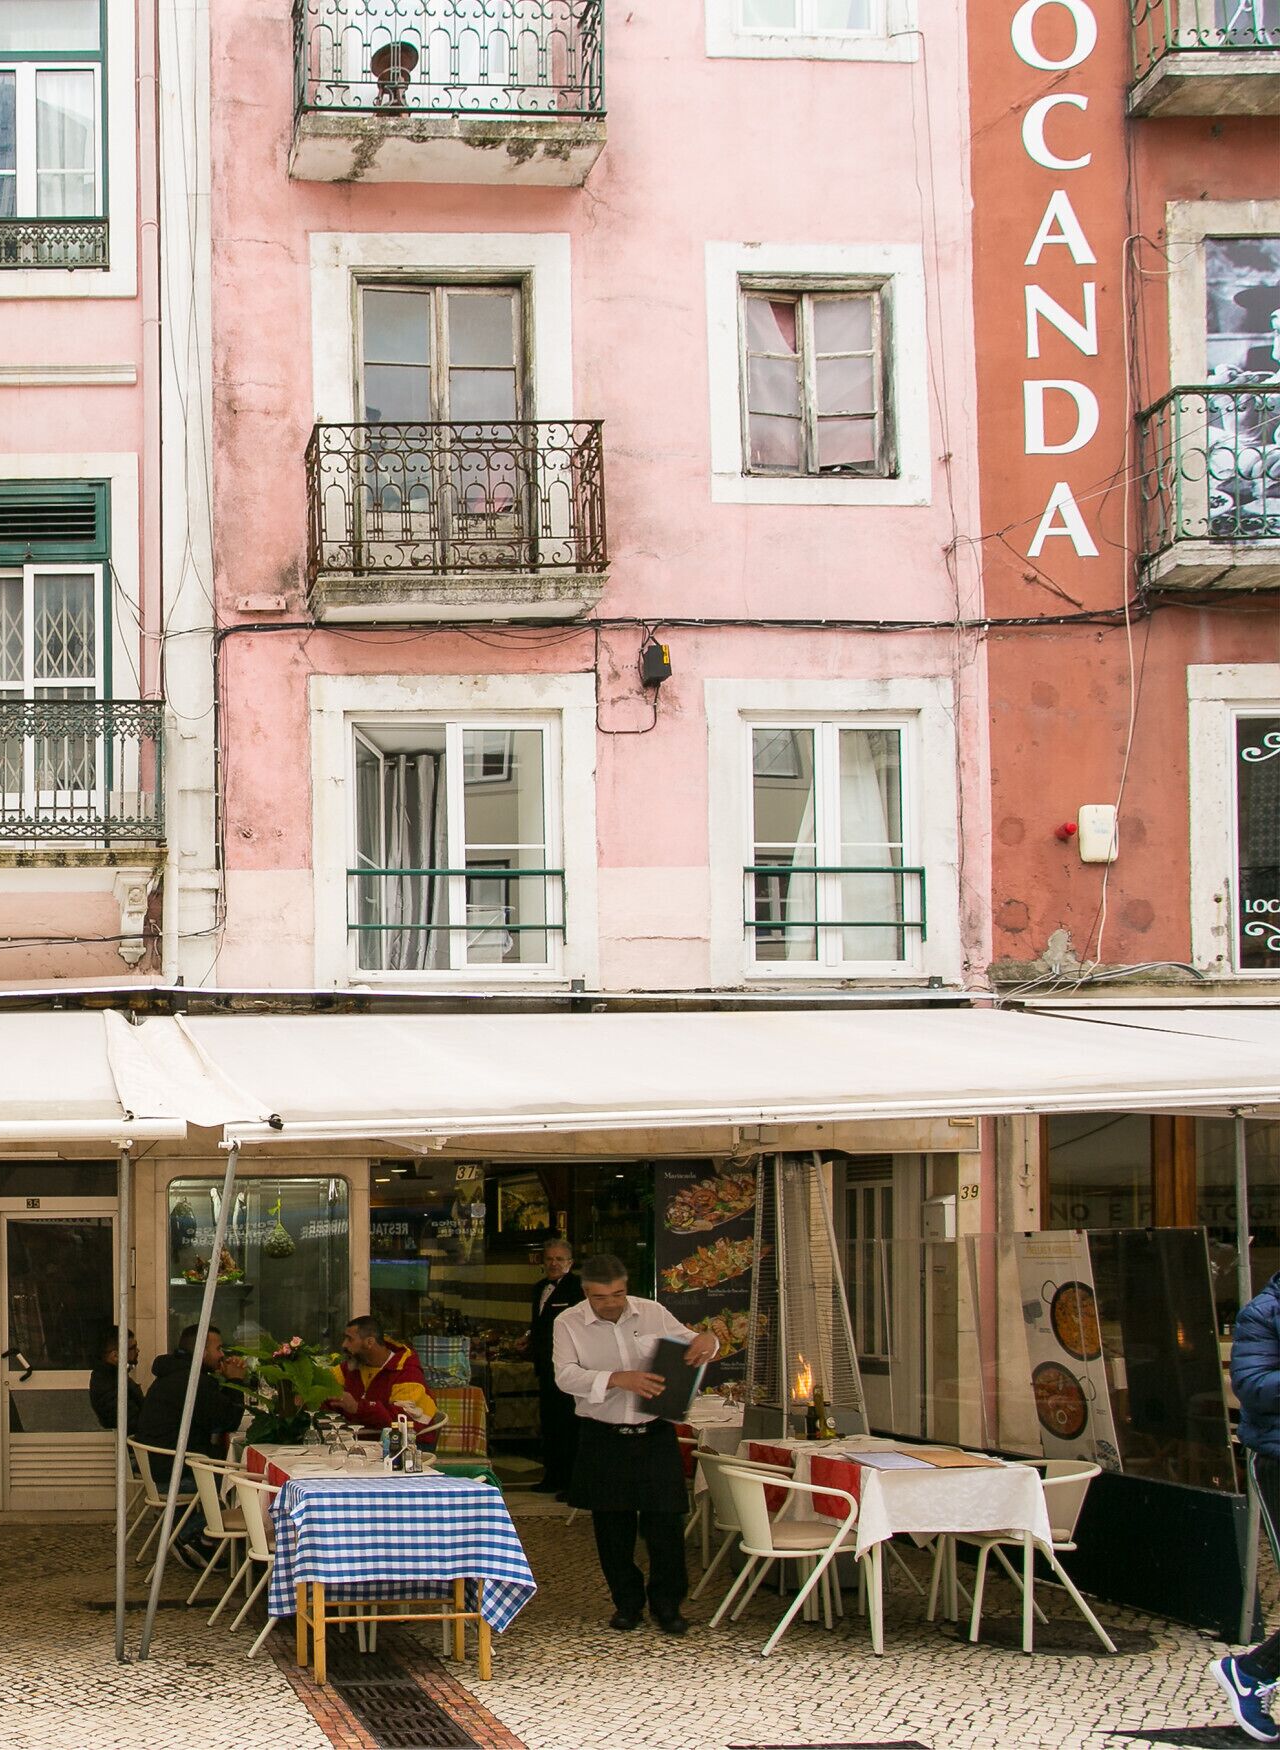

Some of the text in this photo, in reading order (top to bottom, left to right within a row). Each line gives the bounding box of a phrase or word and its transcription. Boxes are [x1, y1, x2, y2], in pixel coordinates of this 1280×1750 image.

[457, 1166, 475, 1179] 37
[961, 1185, 979, 1200] 39
[27, 1200, 39, 1208] 35
